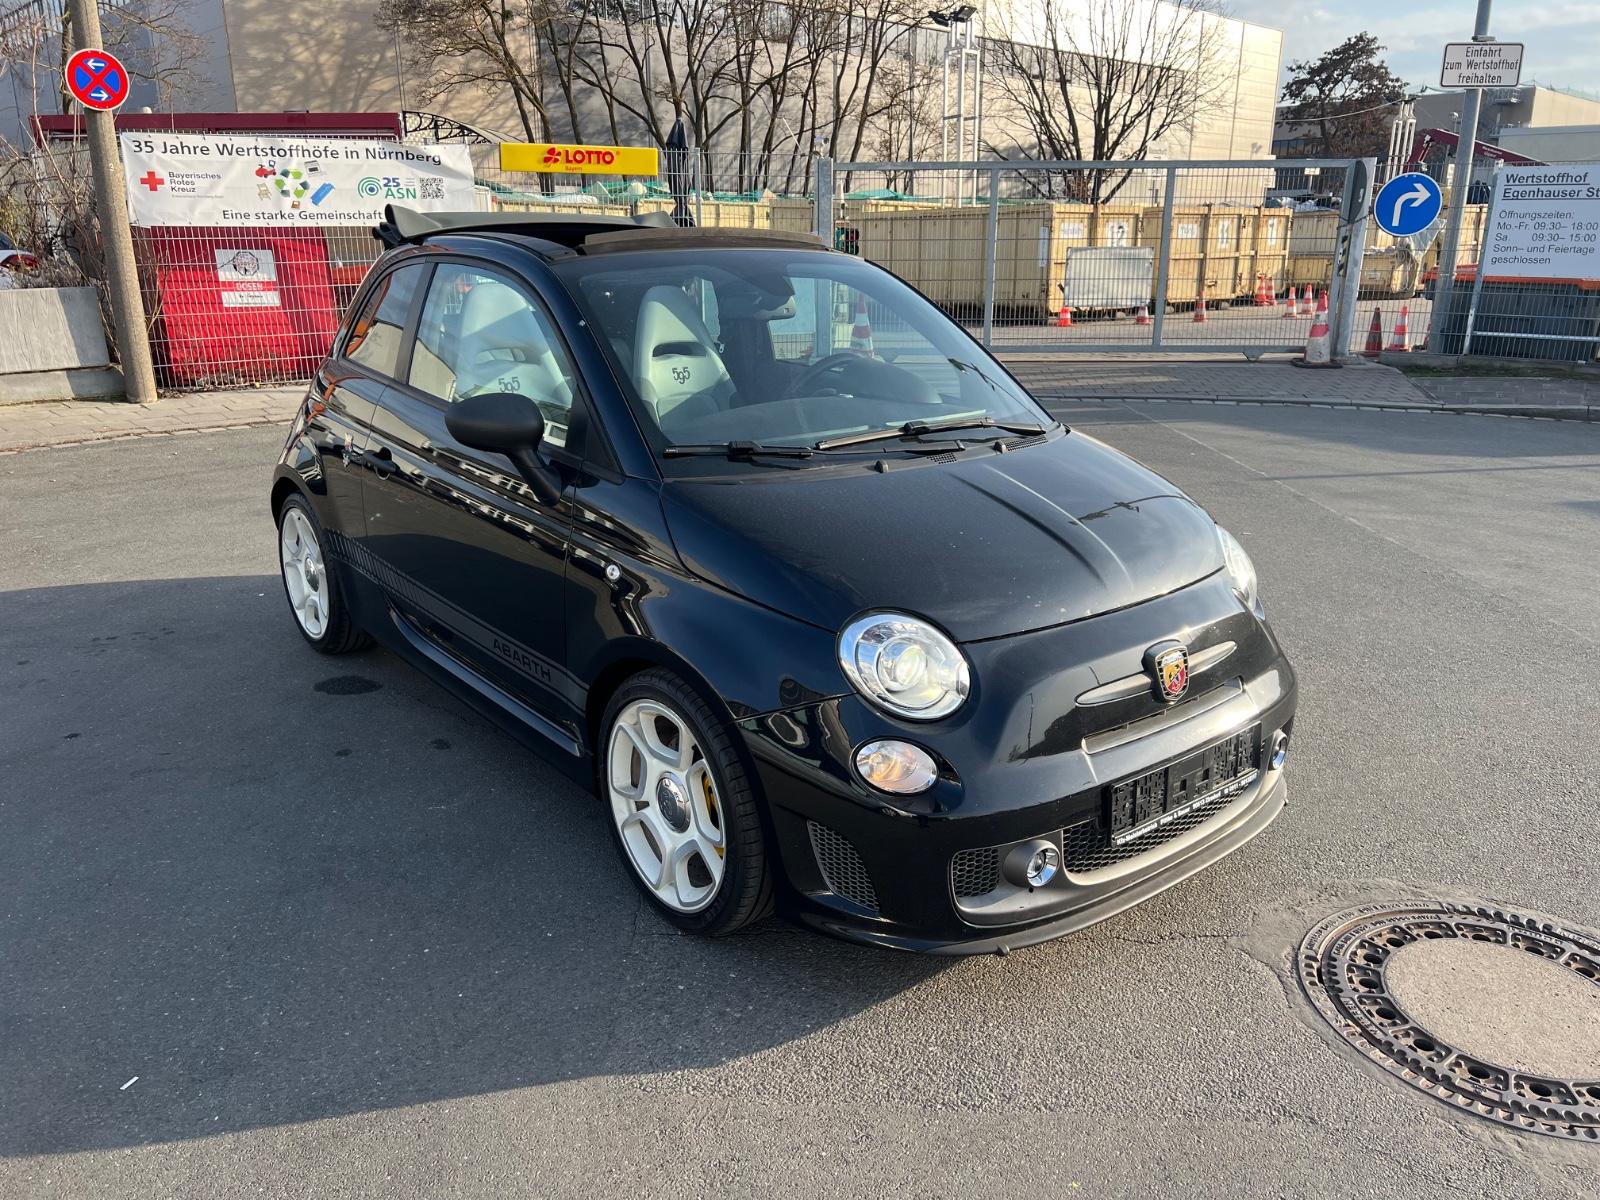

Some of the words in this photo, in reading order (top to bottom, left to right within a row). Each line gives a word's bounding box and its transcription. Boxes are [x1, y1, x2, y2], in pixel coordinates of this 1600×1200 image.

[1465, 47, 1502, 58] Einfahrt
[1445, 61, 1462, 70] zum
[1466, 59, 1519, 70] Wertstoffhof
[1457, 73, 1502, 84] freihalten
[132, 140, 155, 154] 35
[161, 141, 210, 156] Jahre
[215, 143, 339, 159] Wertstoffhöfe
[344, 147, 360, 160] in
[365, 147, 442, 166] Nürnberg
[565, 149, 615, 165] LOTTO
[168, 171, 222, 180] Bayerisches
[1506, 172, 1589, 184] Wertstoffhof
[382, 177, 401, 188] 25
[384, 187, 417, 200] ASN
[1503, 187, 1582, 200] Egenhauser
[222, 210, 251, 220] Eine
[254, 210, 295, 221] starke
[299, 210, 384, 220] Gemeinschaft
[1569, 233, 1596, 243] 15:00
[1527, 244, 1545, 253] und
[1547, 244, 1595, 256] Feiertage
[1491, 256, 1551, 266] geschlossen
[235, 282, 264, 291] DOSEN
[671, 367, 691, 385] 595
[493, 638, 552, 682] ABARTH
